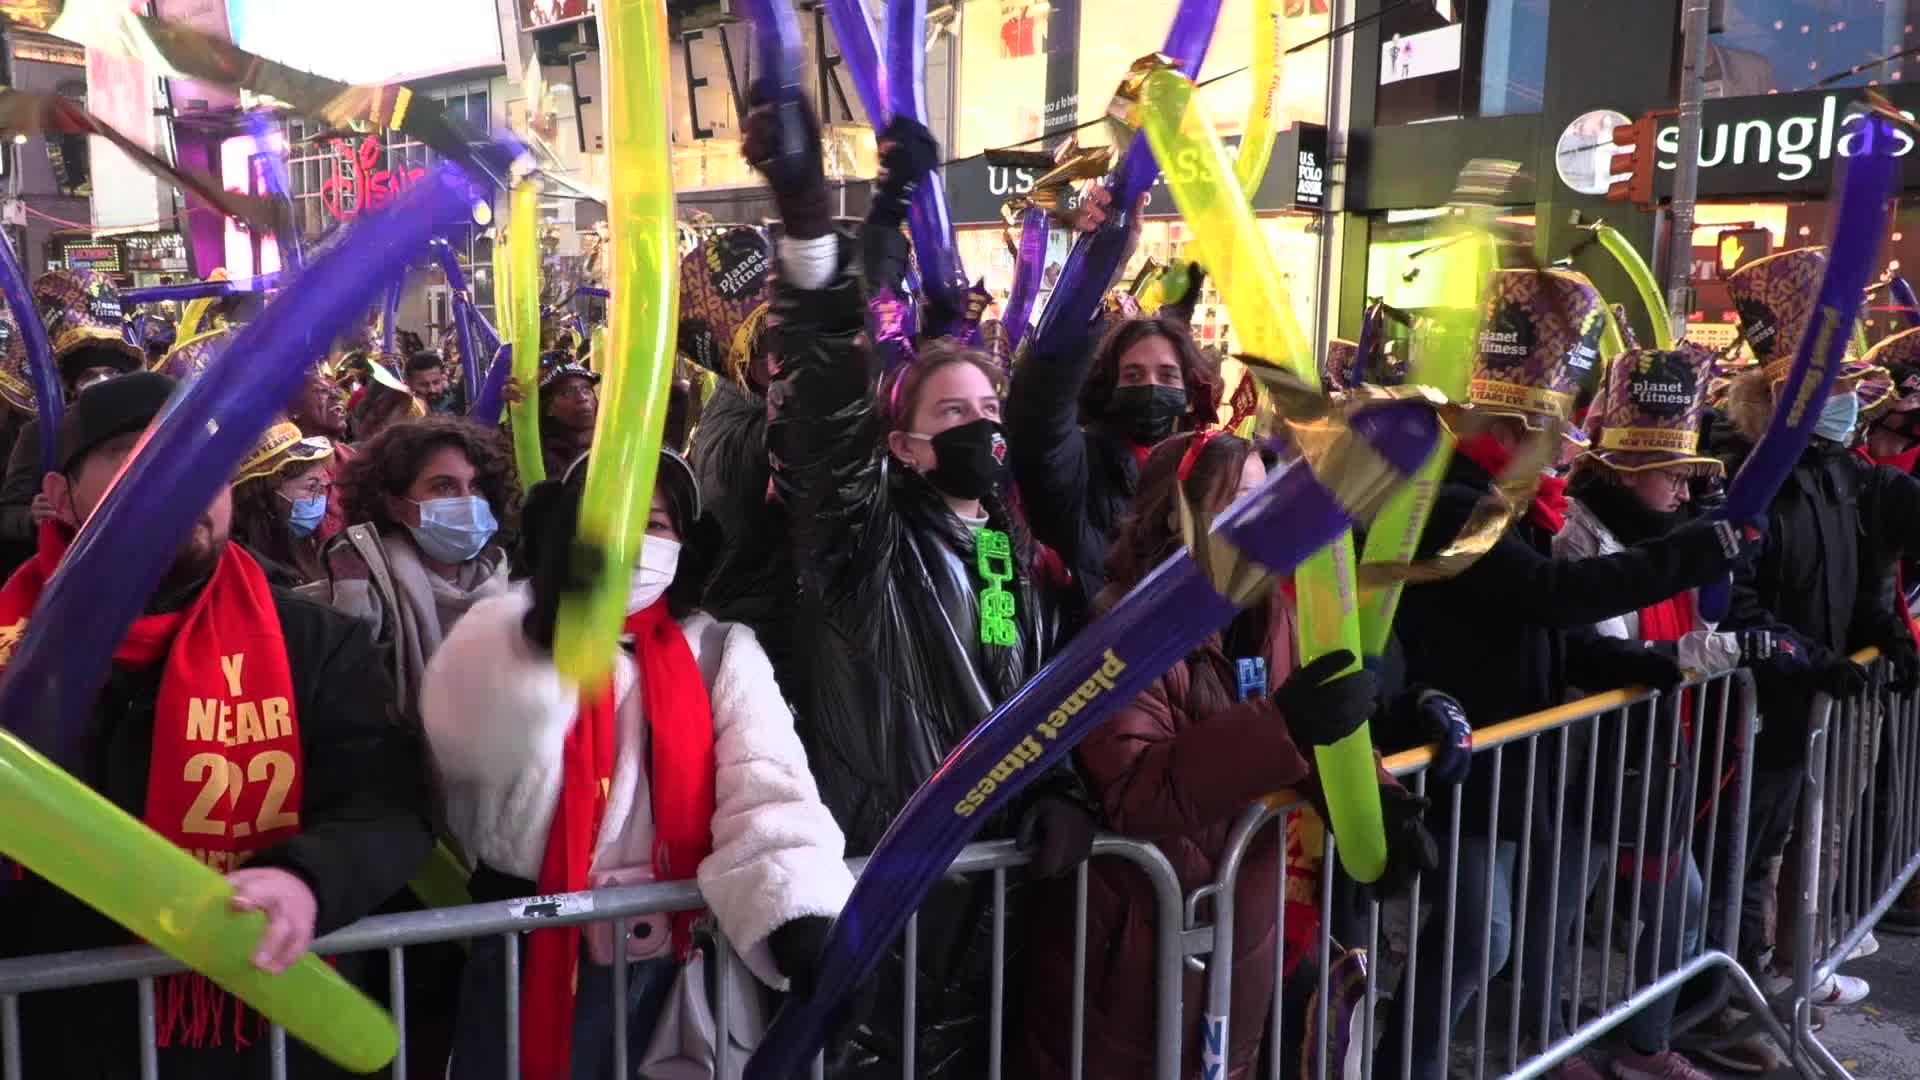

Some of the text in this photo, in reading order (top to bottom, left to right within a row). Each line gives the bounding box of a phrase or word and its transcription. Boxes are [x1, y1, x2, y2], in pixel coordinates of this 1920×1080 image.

[1298, 165, 1323, 182] POLO
[719, 249, 763, 294] planet
[728, 259, 769, 294] fitnes
[1633, 380, 1683, 394] planet
[1639, 391, 1692, 405] fitness
[186, 696, 292, 748] NEAR
[953, 647, 1127, 817] planet fitness
